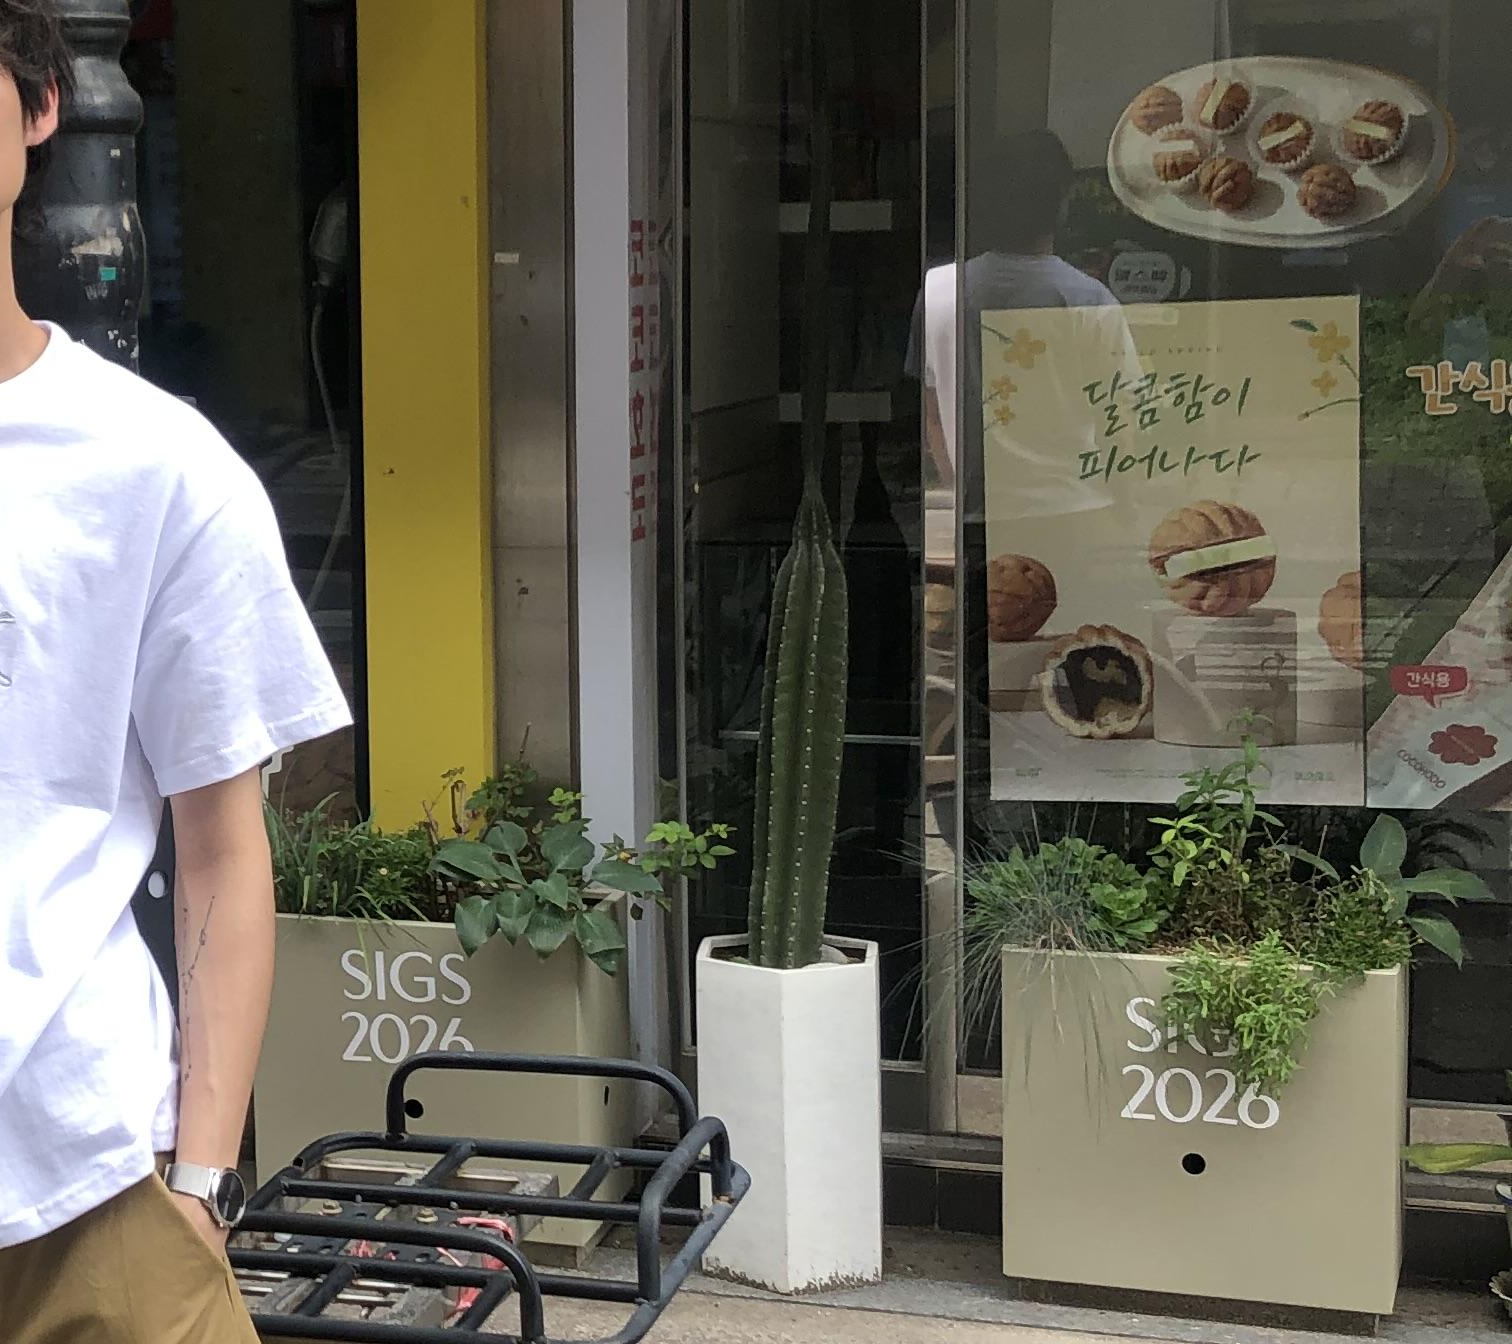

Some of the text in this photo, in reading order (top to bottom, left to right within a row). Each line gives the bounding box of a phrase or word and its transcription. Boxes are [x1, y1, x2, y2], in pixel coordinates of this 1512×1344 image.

[1082, 370, 1252, 437] 달콤함이
[1405, 358, 1512, 415] 간식
[1078, 444, 1263, 484] 피어나다
[1406, 671, 1451, 688] 간식용
[341, 949, 472, 1005] SIGS
[340, 1011, 474, 1064] 2026
[1120, 1064, 1280, 1129] 2026
